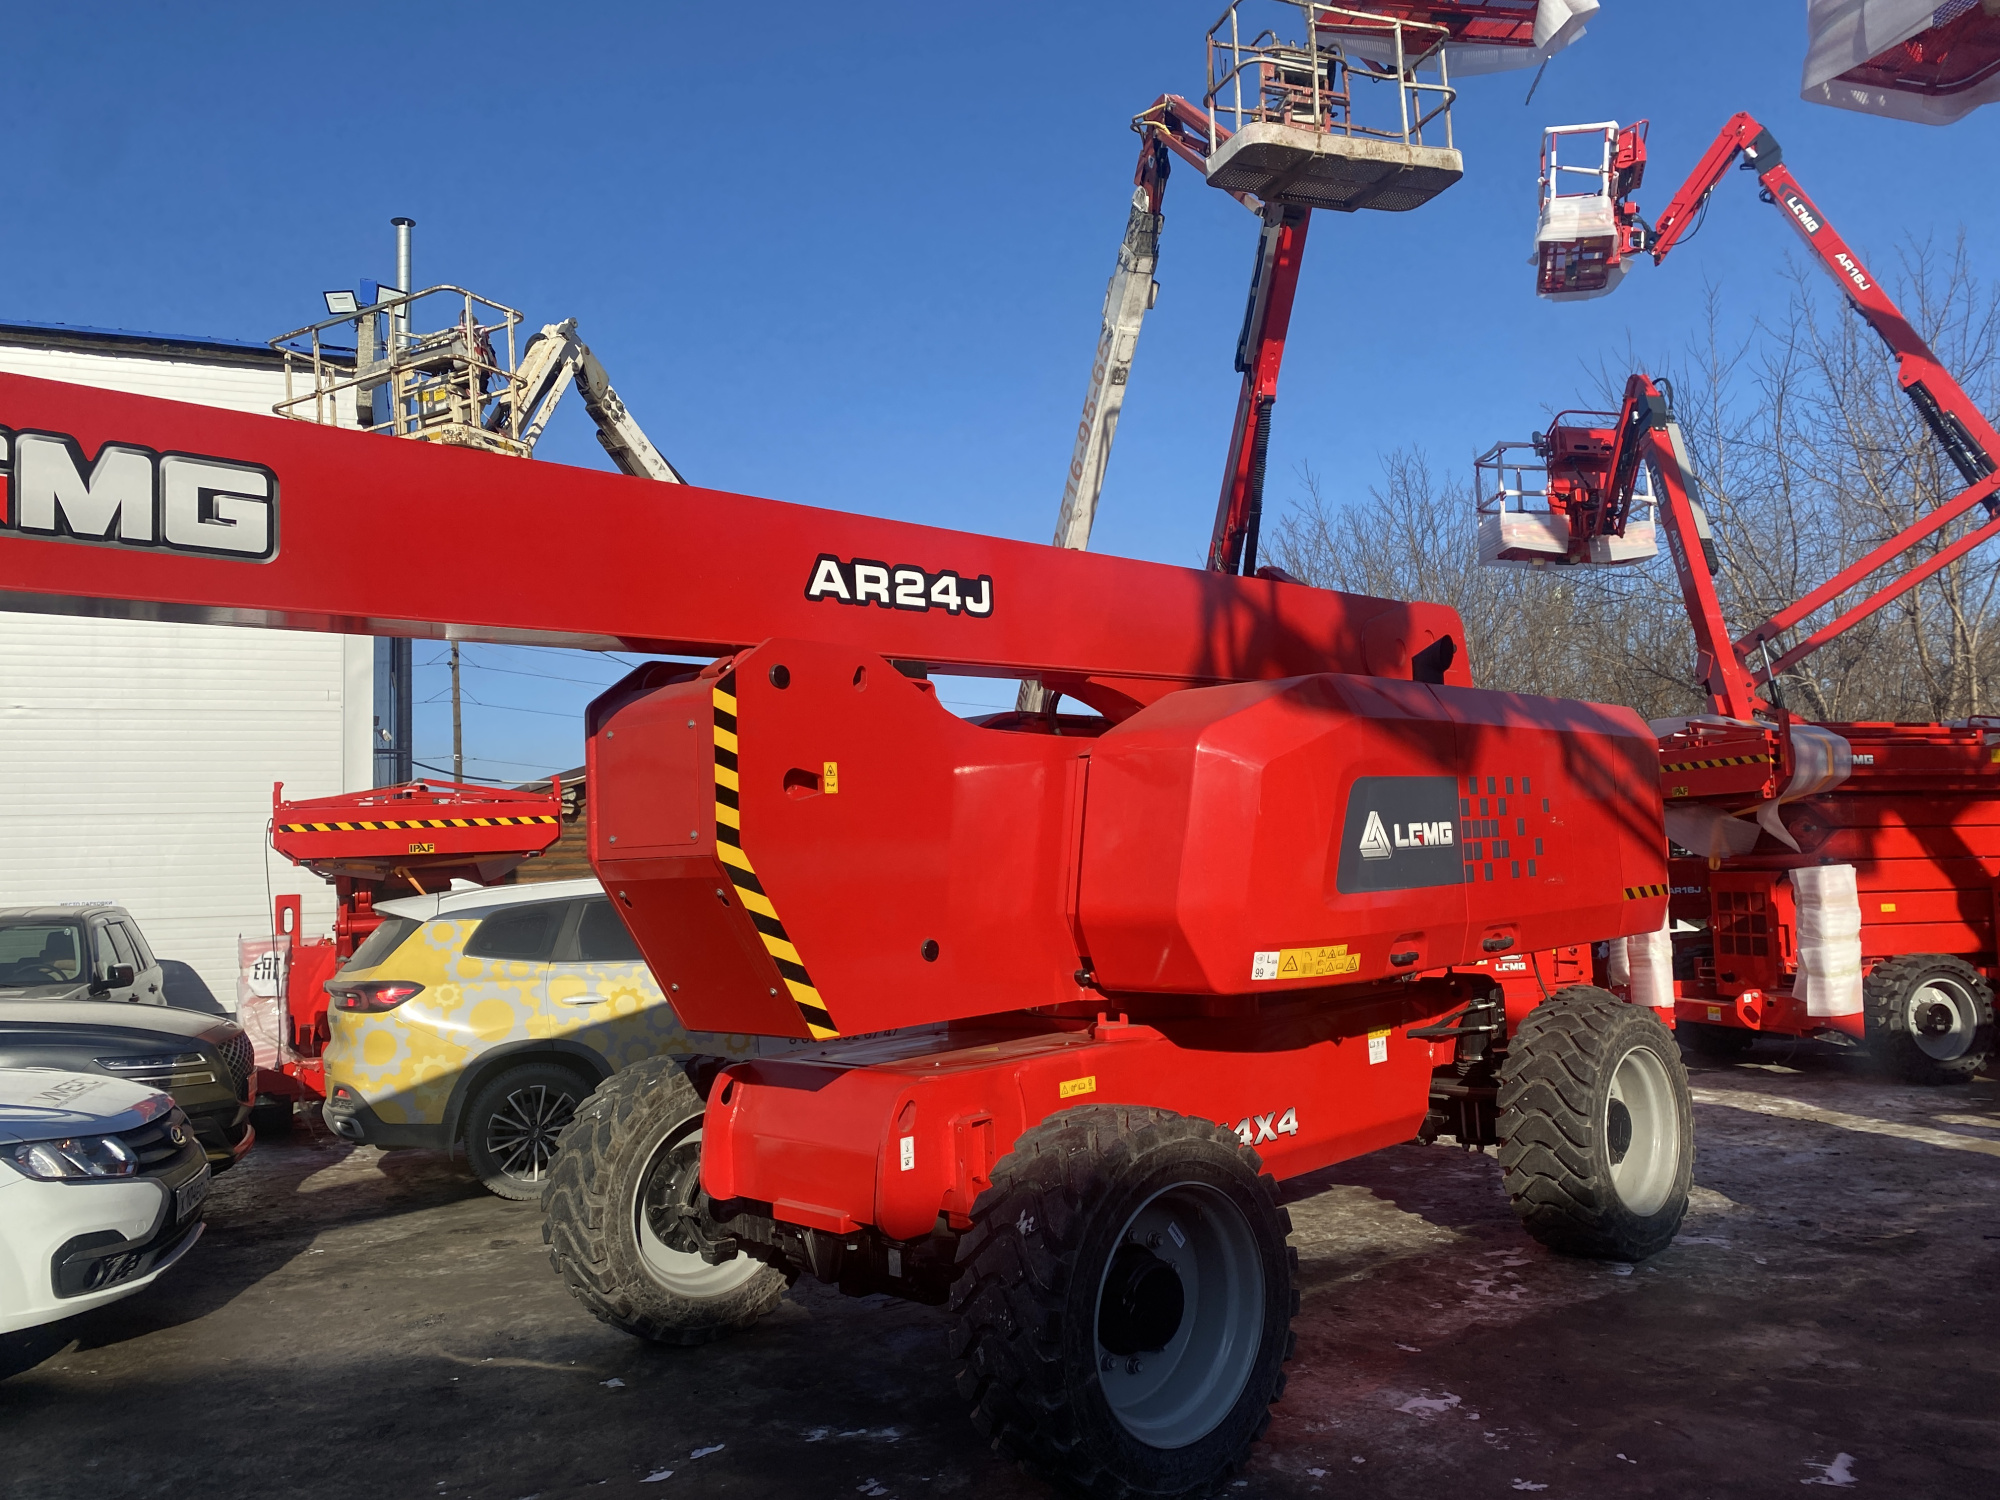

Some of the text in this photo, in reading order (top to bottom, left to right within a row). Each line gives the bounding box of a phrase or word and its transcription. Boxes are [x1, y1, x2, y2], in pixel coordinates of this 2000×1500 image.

[0, 432, 275, 559] MG
[807, 557, 992, 615] AR24J
[410, 842, 434, 853] IPAF
[1233, 1106, 1299, 1146] 4X4
